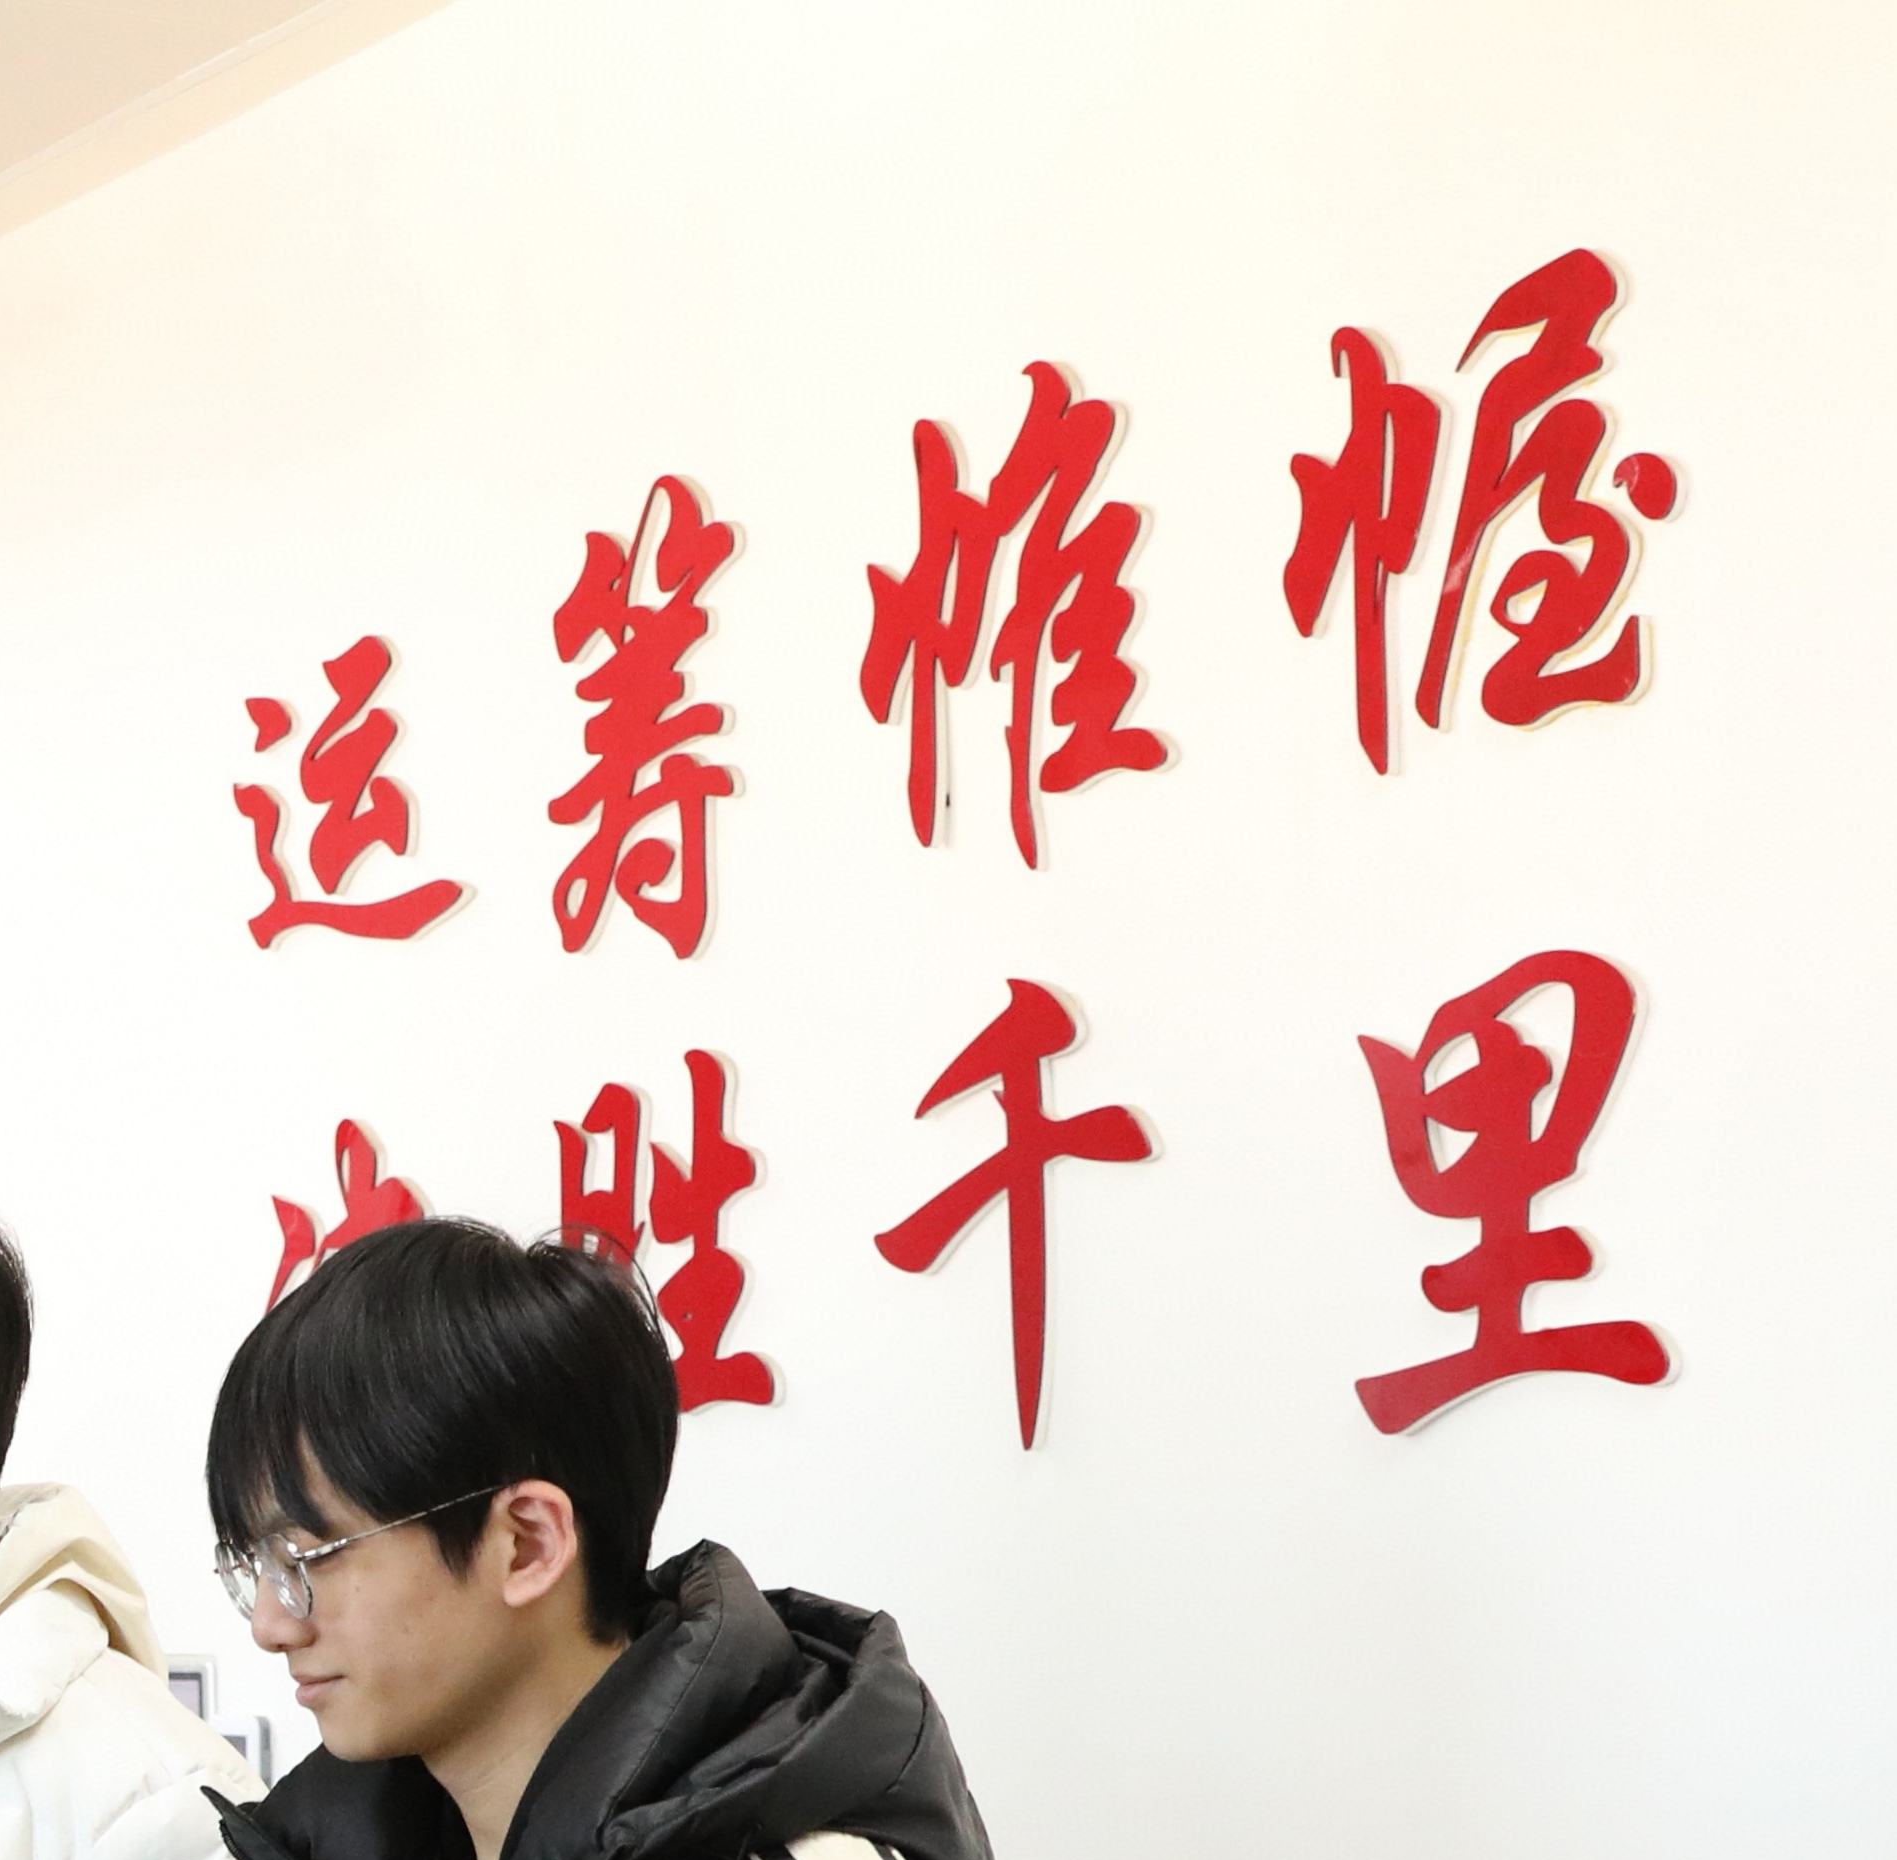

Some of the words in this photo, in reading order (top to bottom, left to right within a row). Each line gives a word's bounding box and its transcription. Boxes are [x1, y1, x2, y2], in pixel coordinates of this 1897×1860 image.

[233, 247, 1678, 960] 运筹帷幄
[269, 948, 1672, 1450] 胜千里
